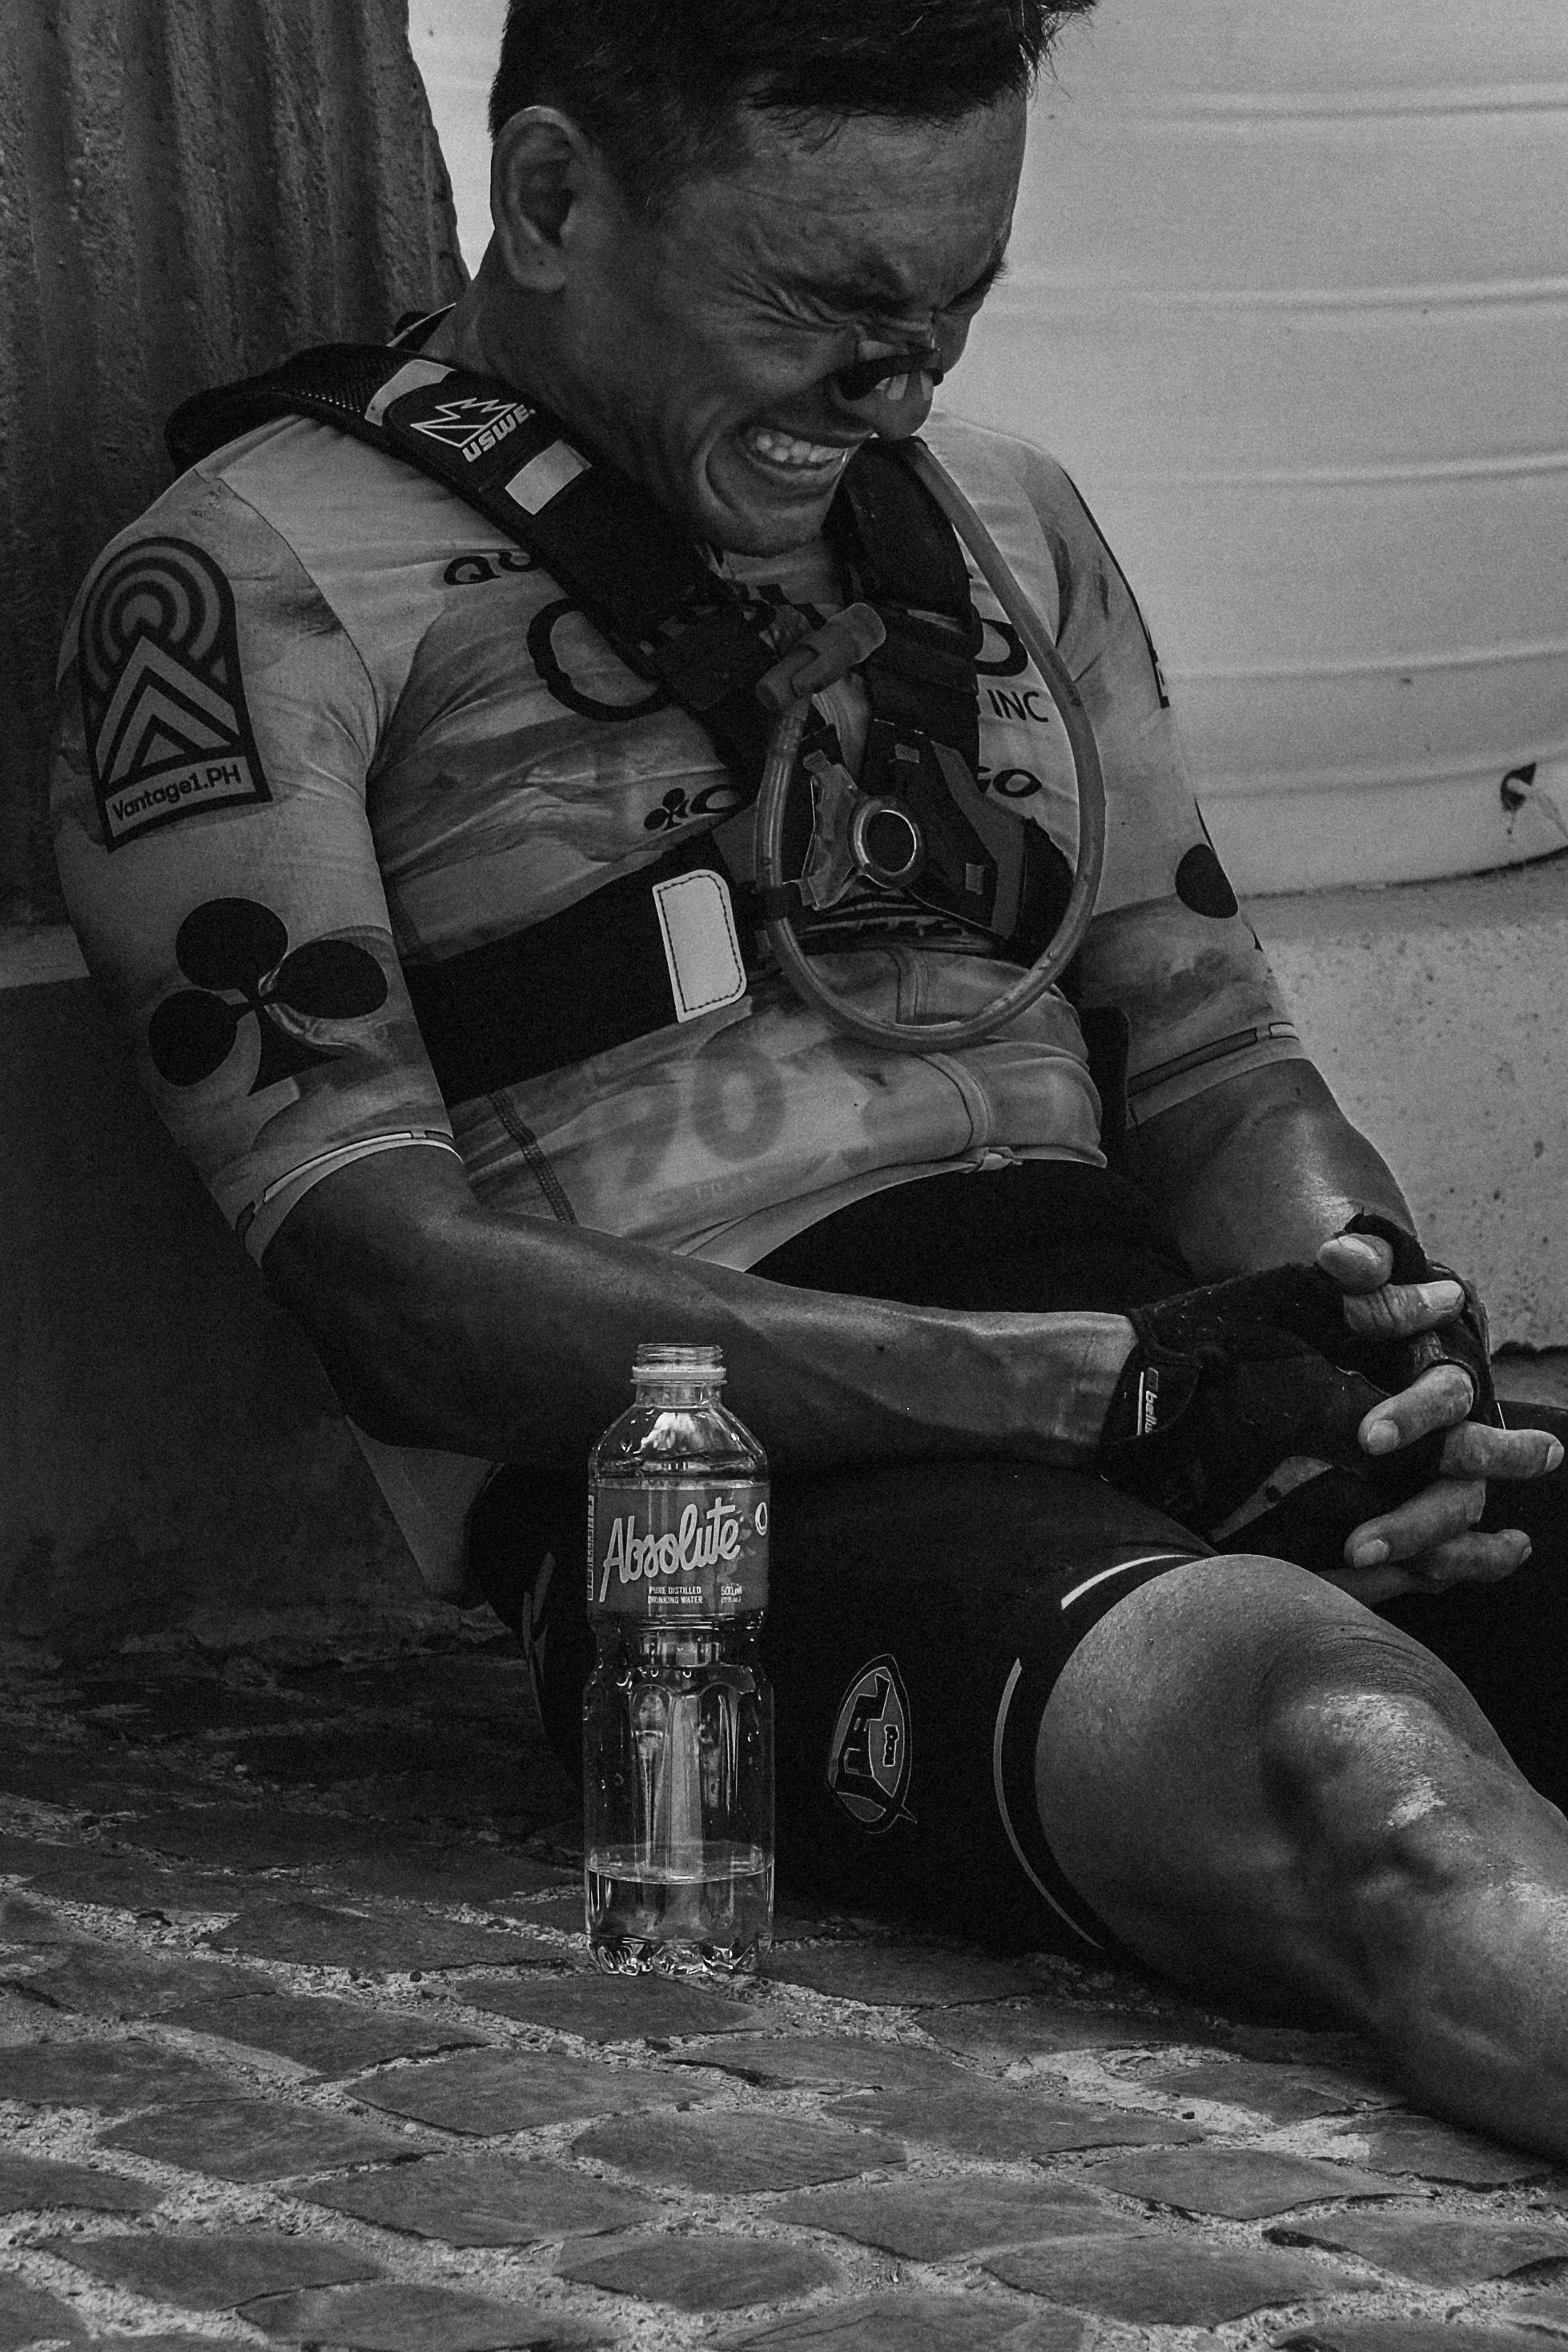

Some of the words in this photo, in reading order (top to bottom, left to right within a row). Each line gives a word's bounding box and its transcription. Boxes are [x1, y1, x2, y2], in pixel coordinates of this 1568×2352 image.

[112, 764, 241, 822] Vantage1.PH
[599, 1497, 741, 1602] Absolute
[648, 1595, 679, 1604] DRINKING
[680, 1595, 703, 1604] WATER
[649, 1586, 666, 1594] PURE
[668, 1586, 702, 1594] DISTILLED
